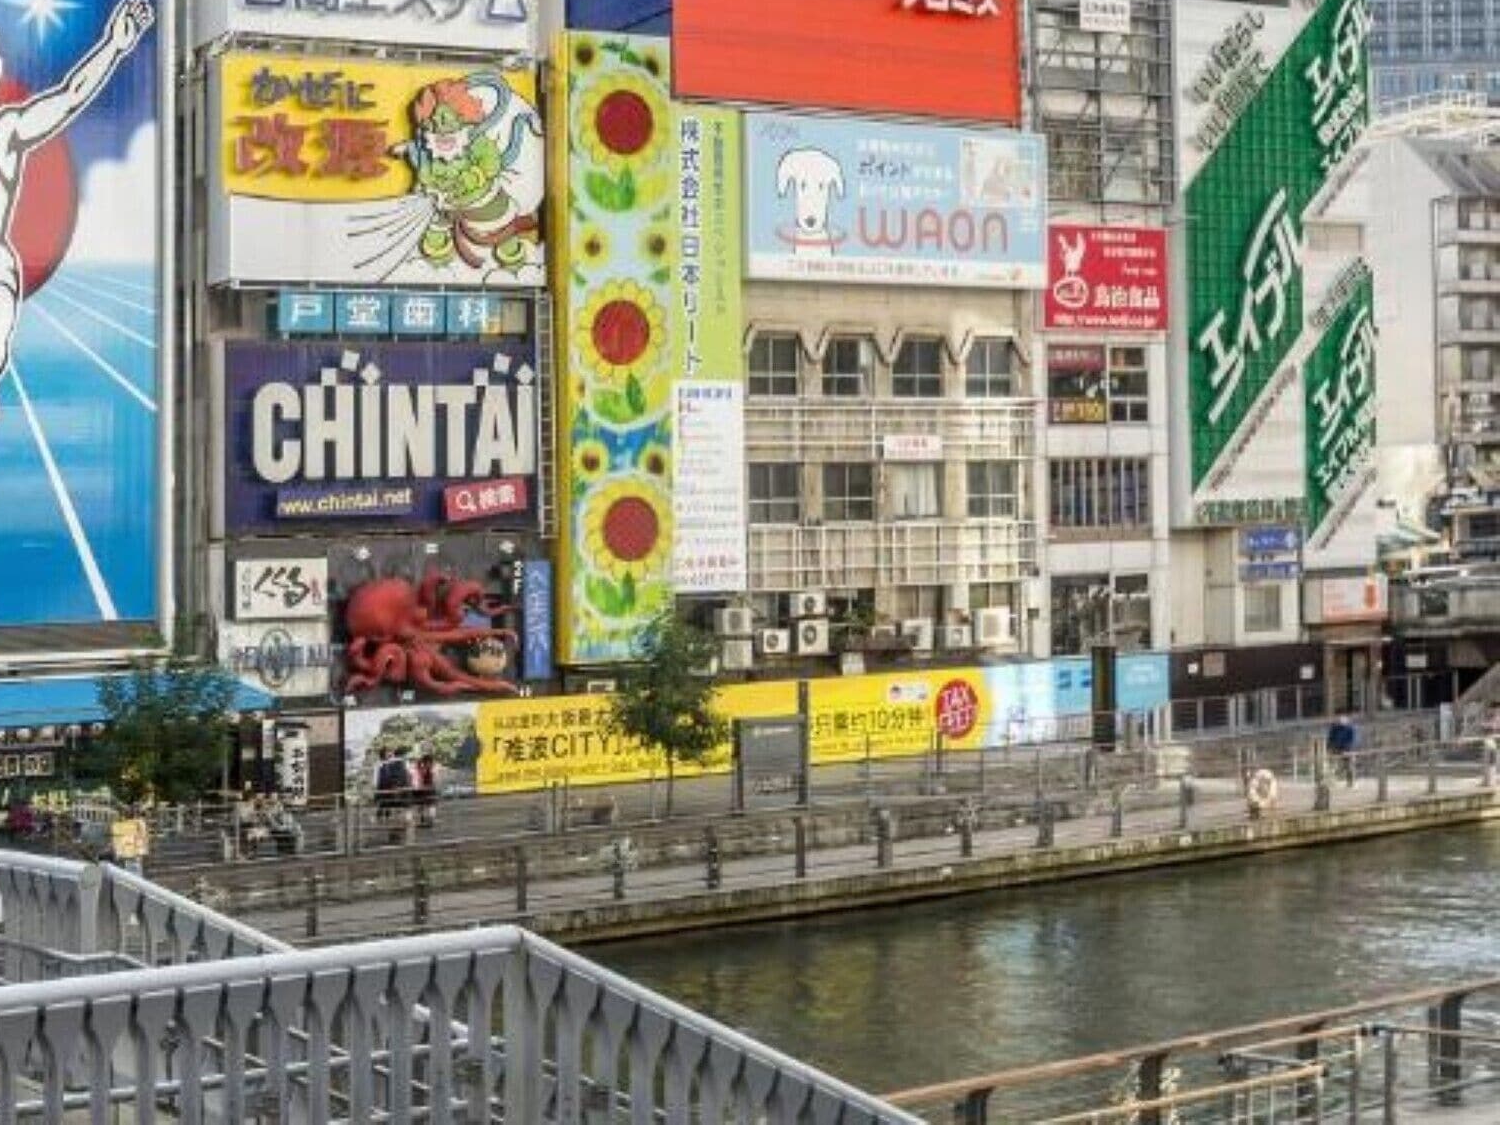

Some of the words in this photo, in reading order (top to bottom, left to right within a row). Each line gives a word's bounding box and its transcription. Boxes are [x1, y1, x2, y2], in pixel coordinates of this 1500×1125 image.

[250, 67, 378, 112] かぜに
[858, 206, 1009, 254] WAON
[1198, 188, 1308, 423] エイブル
[252, 351, 536, 485] CHINTAI
